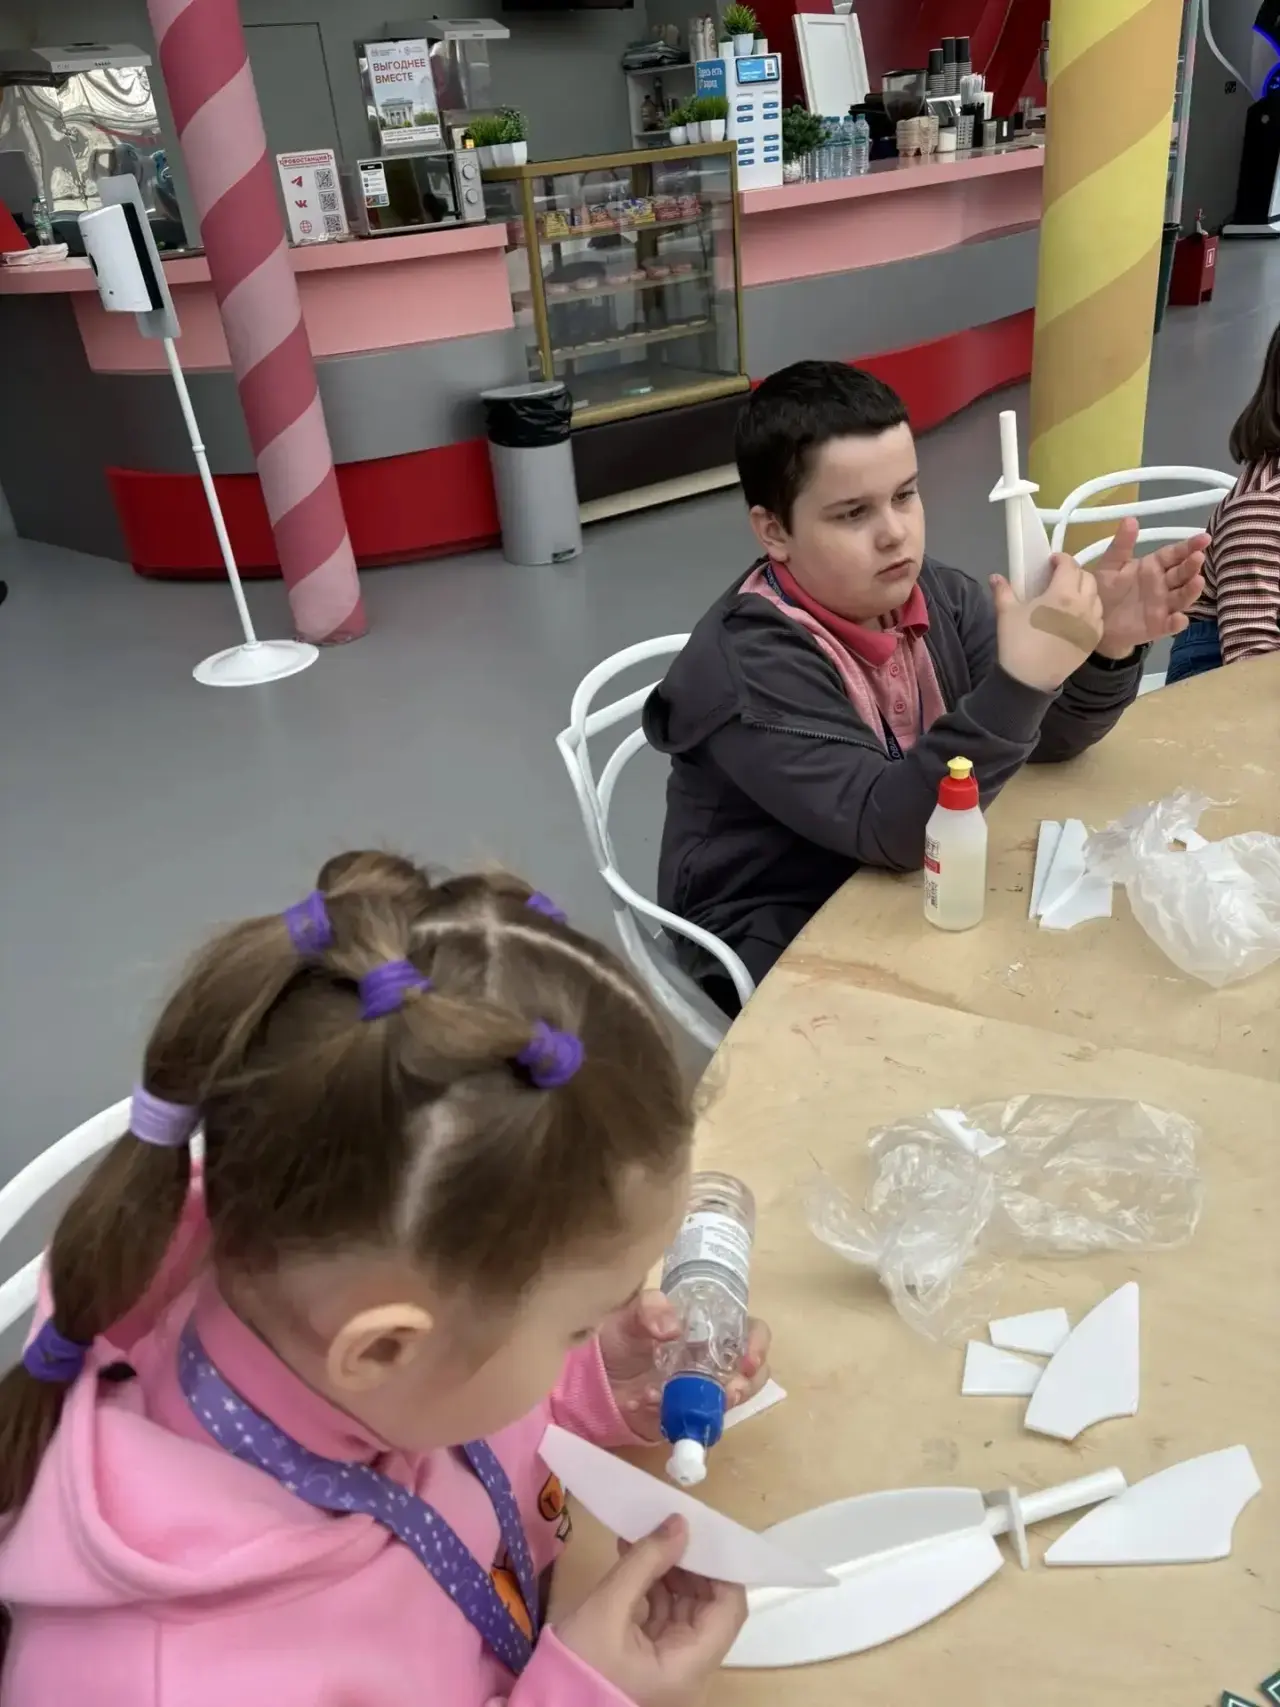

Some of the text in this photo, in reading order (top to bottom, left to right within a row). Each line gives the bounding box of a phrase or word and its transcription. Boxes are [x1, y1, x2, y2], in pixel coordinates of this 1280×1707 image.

[373, 58, 426, 72] ВЫГОДНЕЕ
[375, 72, 414, 84] ВМЕСТЕ
[284, 155, 328, 164] РОБОСТАНЦИЯ
